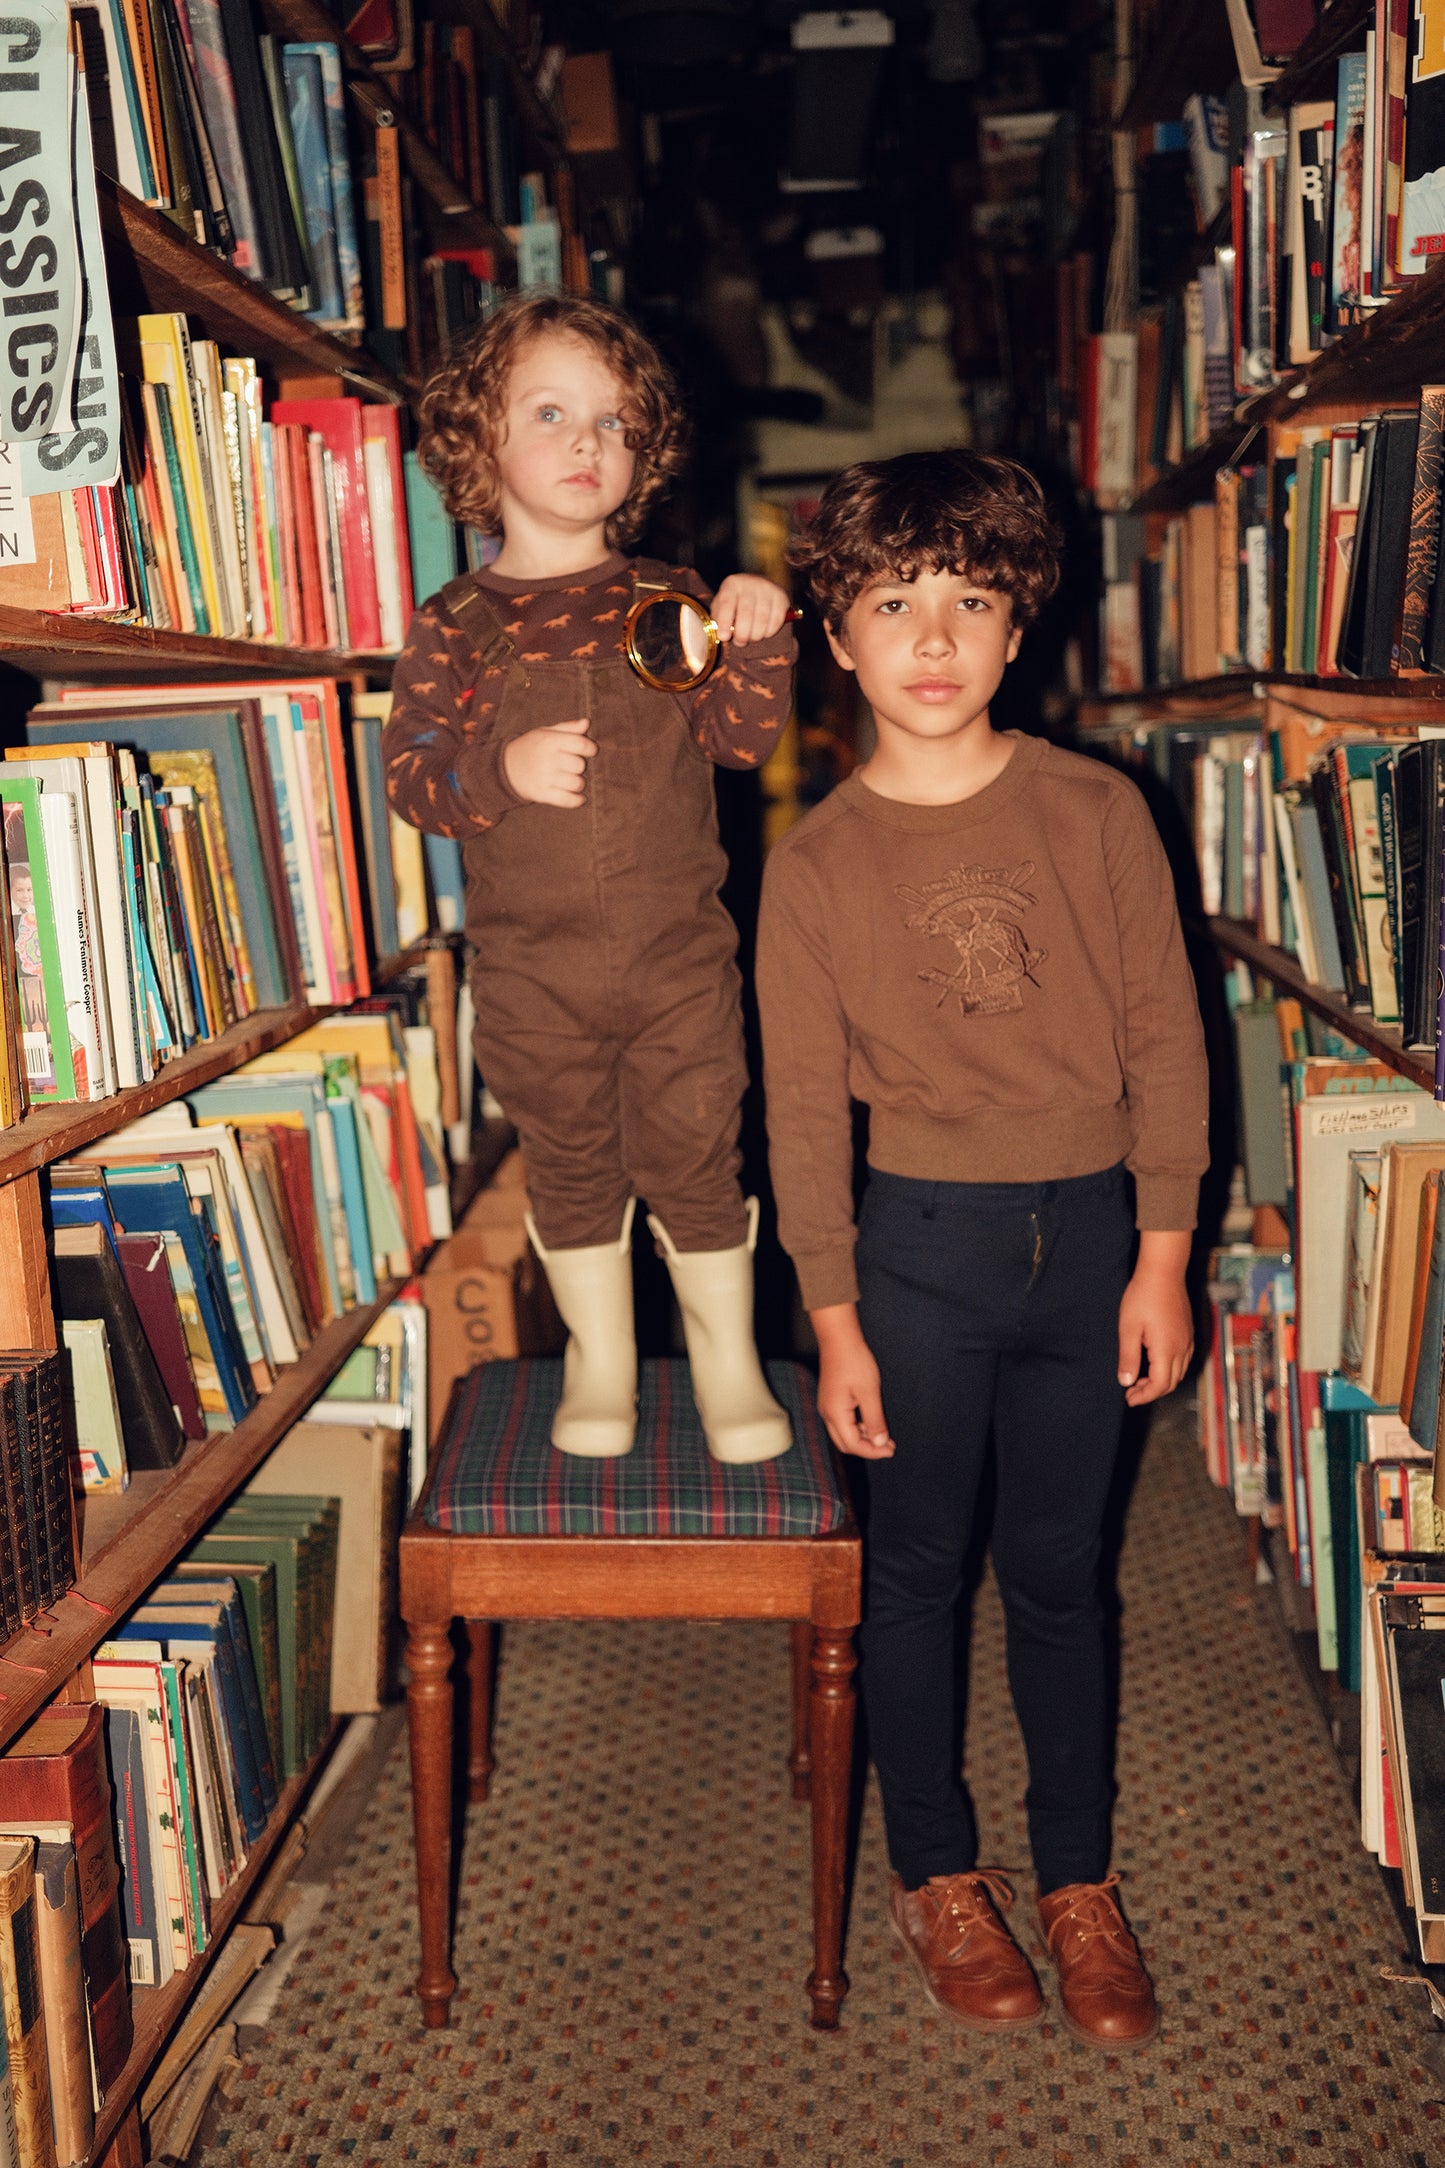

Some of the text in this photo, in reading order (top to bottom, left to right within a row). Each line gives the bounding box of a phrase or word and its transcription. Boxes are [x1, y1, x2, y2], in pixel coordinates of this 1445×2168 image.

[76, 908, 86, 940] James
[79, 941, 89, 983] Fenimore
[81, 984, 93, 1016] Cooper
